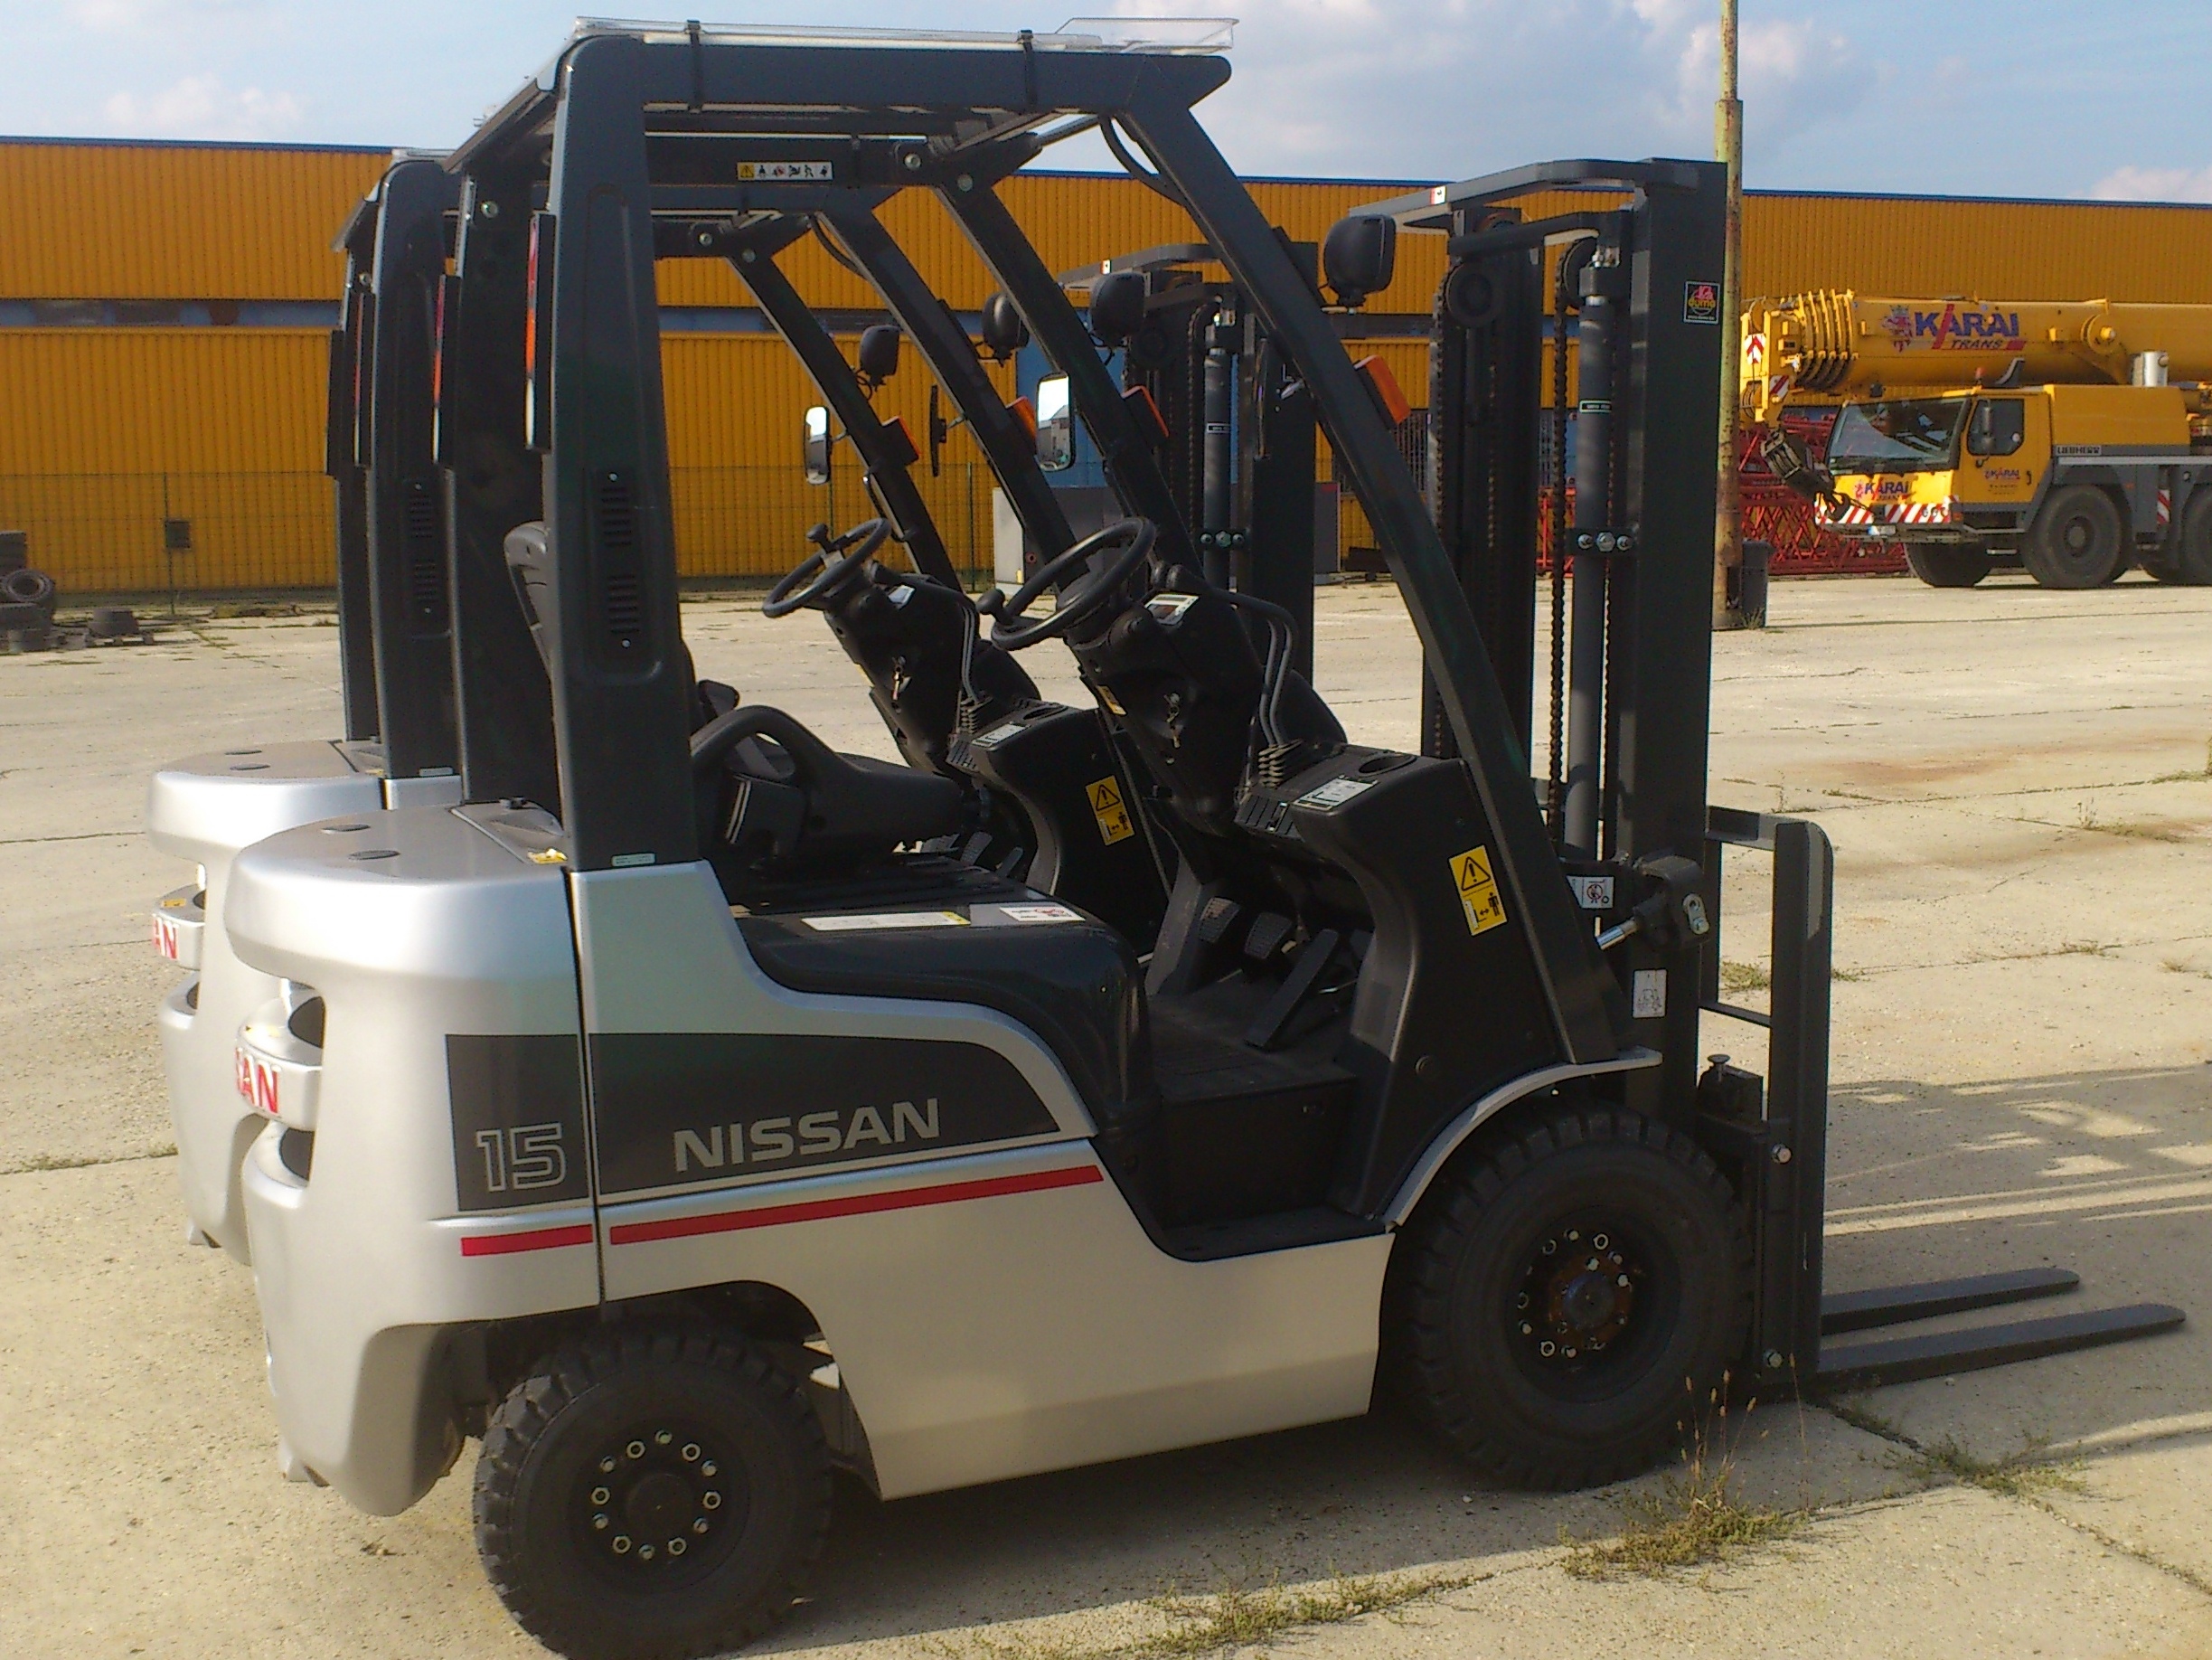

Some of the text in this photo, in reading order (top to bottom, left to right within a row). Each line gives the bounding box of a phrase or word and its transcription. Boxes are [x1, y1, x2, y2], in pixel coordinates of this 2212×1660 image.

[1914, 307, 2019, 339] KARAI
[1951, 338, 2003, 349] TRANS
[1864, 479, 1909, 495] KARAI
[673, 1097, 941, 1173] NISSAN
[475, 1122, 568, 1193] 15
